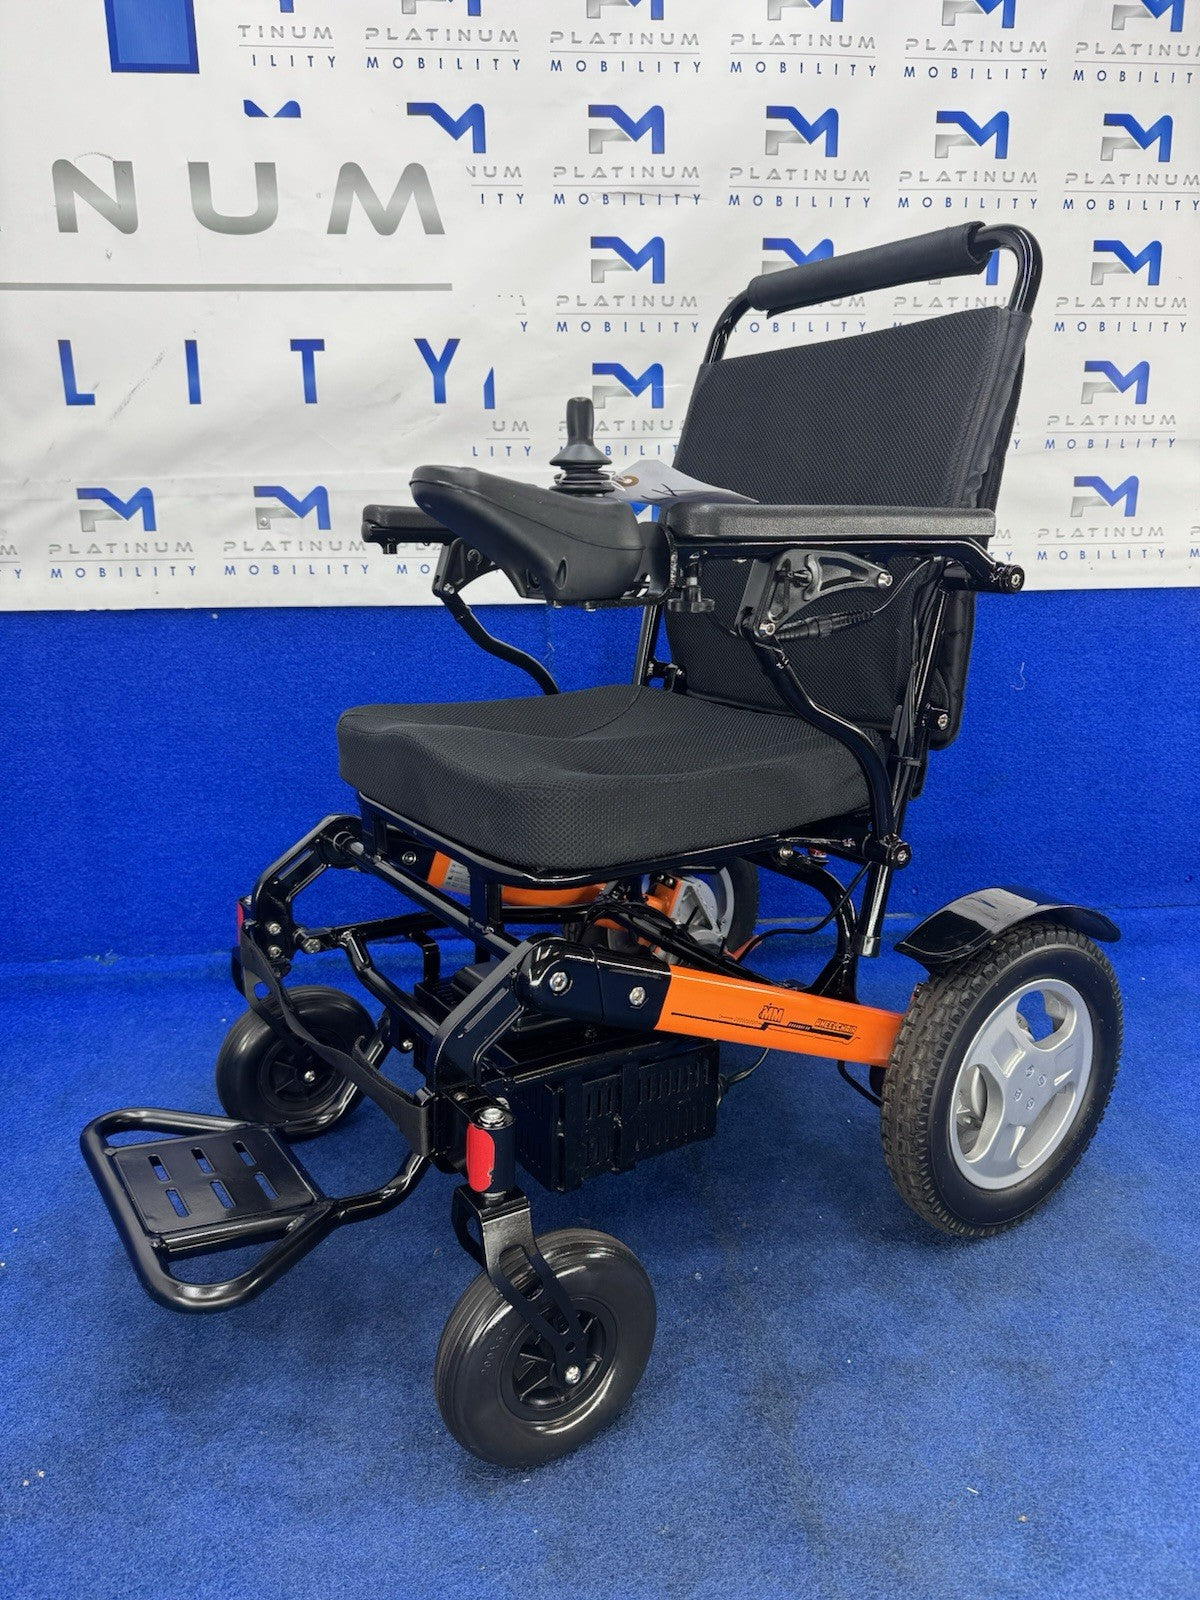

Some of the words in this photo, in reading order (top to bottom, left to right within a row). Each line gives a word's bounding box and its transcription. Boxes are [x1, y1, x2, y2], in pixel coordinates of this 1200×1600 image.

[238, 25, 333, 39] TINUM
[365, 28, 518, 42] PLATINUM
[550, 31, 699, 45] PLATINUM
[731, 32, 875, 49] PLATINUM
[906, 38, 1047, 53] PLATINUM
[252, 54, 335, 68] ILITY
[367, 56, 520, 71] MOBILITY
[550, 59, 701, 73] MOBILITY
[730, 61, 876, 77] MOBILITY
[904, 66, 1047, 80] MOBILITY
[553, 166, 699, 178] PLATINUM
[730, 167, 869, 182] PLATINUM
[899, 171, 1037, 183] PLATINUM
[1065, 172, 1200, 186] PLATINUM
[481, 193, 524, 204] ITY
[553, 193, 702, 206] MOBILITY
[728, 194, 870, 208] MOBILITY
[898, 197, 1037, 210] MOBILITY
[1063, 199, 1200, 211] MOBILITY
[557, 295, 697, 307] PLATINUM
[1056, 297, 1187, 308] PLATINUM
[556, 321, 698, 333] MOBILITY
[734, 321, 867, 333] OBILITY
[1054, 321, 1186, 332] MOBILITY
[1047, 415, 1176, 426] PLATINUM
[1045, 438, 1176, 450] MOBILITY
[473, 446, 531, 457] LITY
[1038, 527, 1163, 538] PLATINUM
[48, 542, 193, 554] PLATINUM
[224, 540, 367, 552] PLATINUM
[1037, 549, 1165, 560] MOBILITY
[51, 566, 196, 578] MOBILITY
[225, 564, 369, 575] MOBILITY
